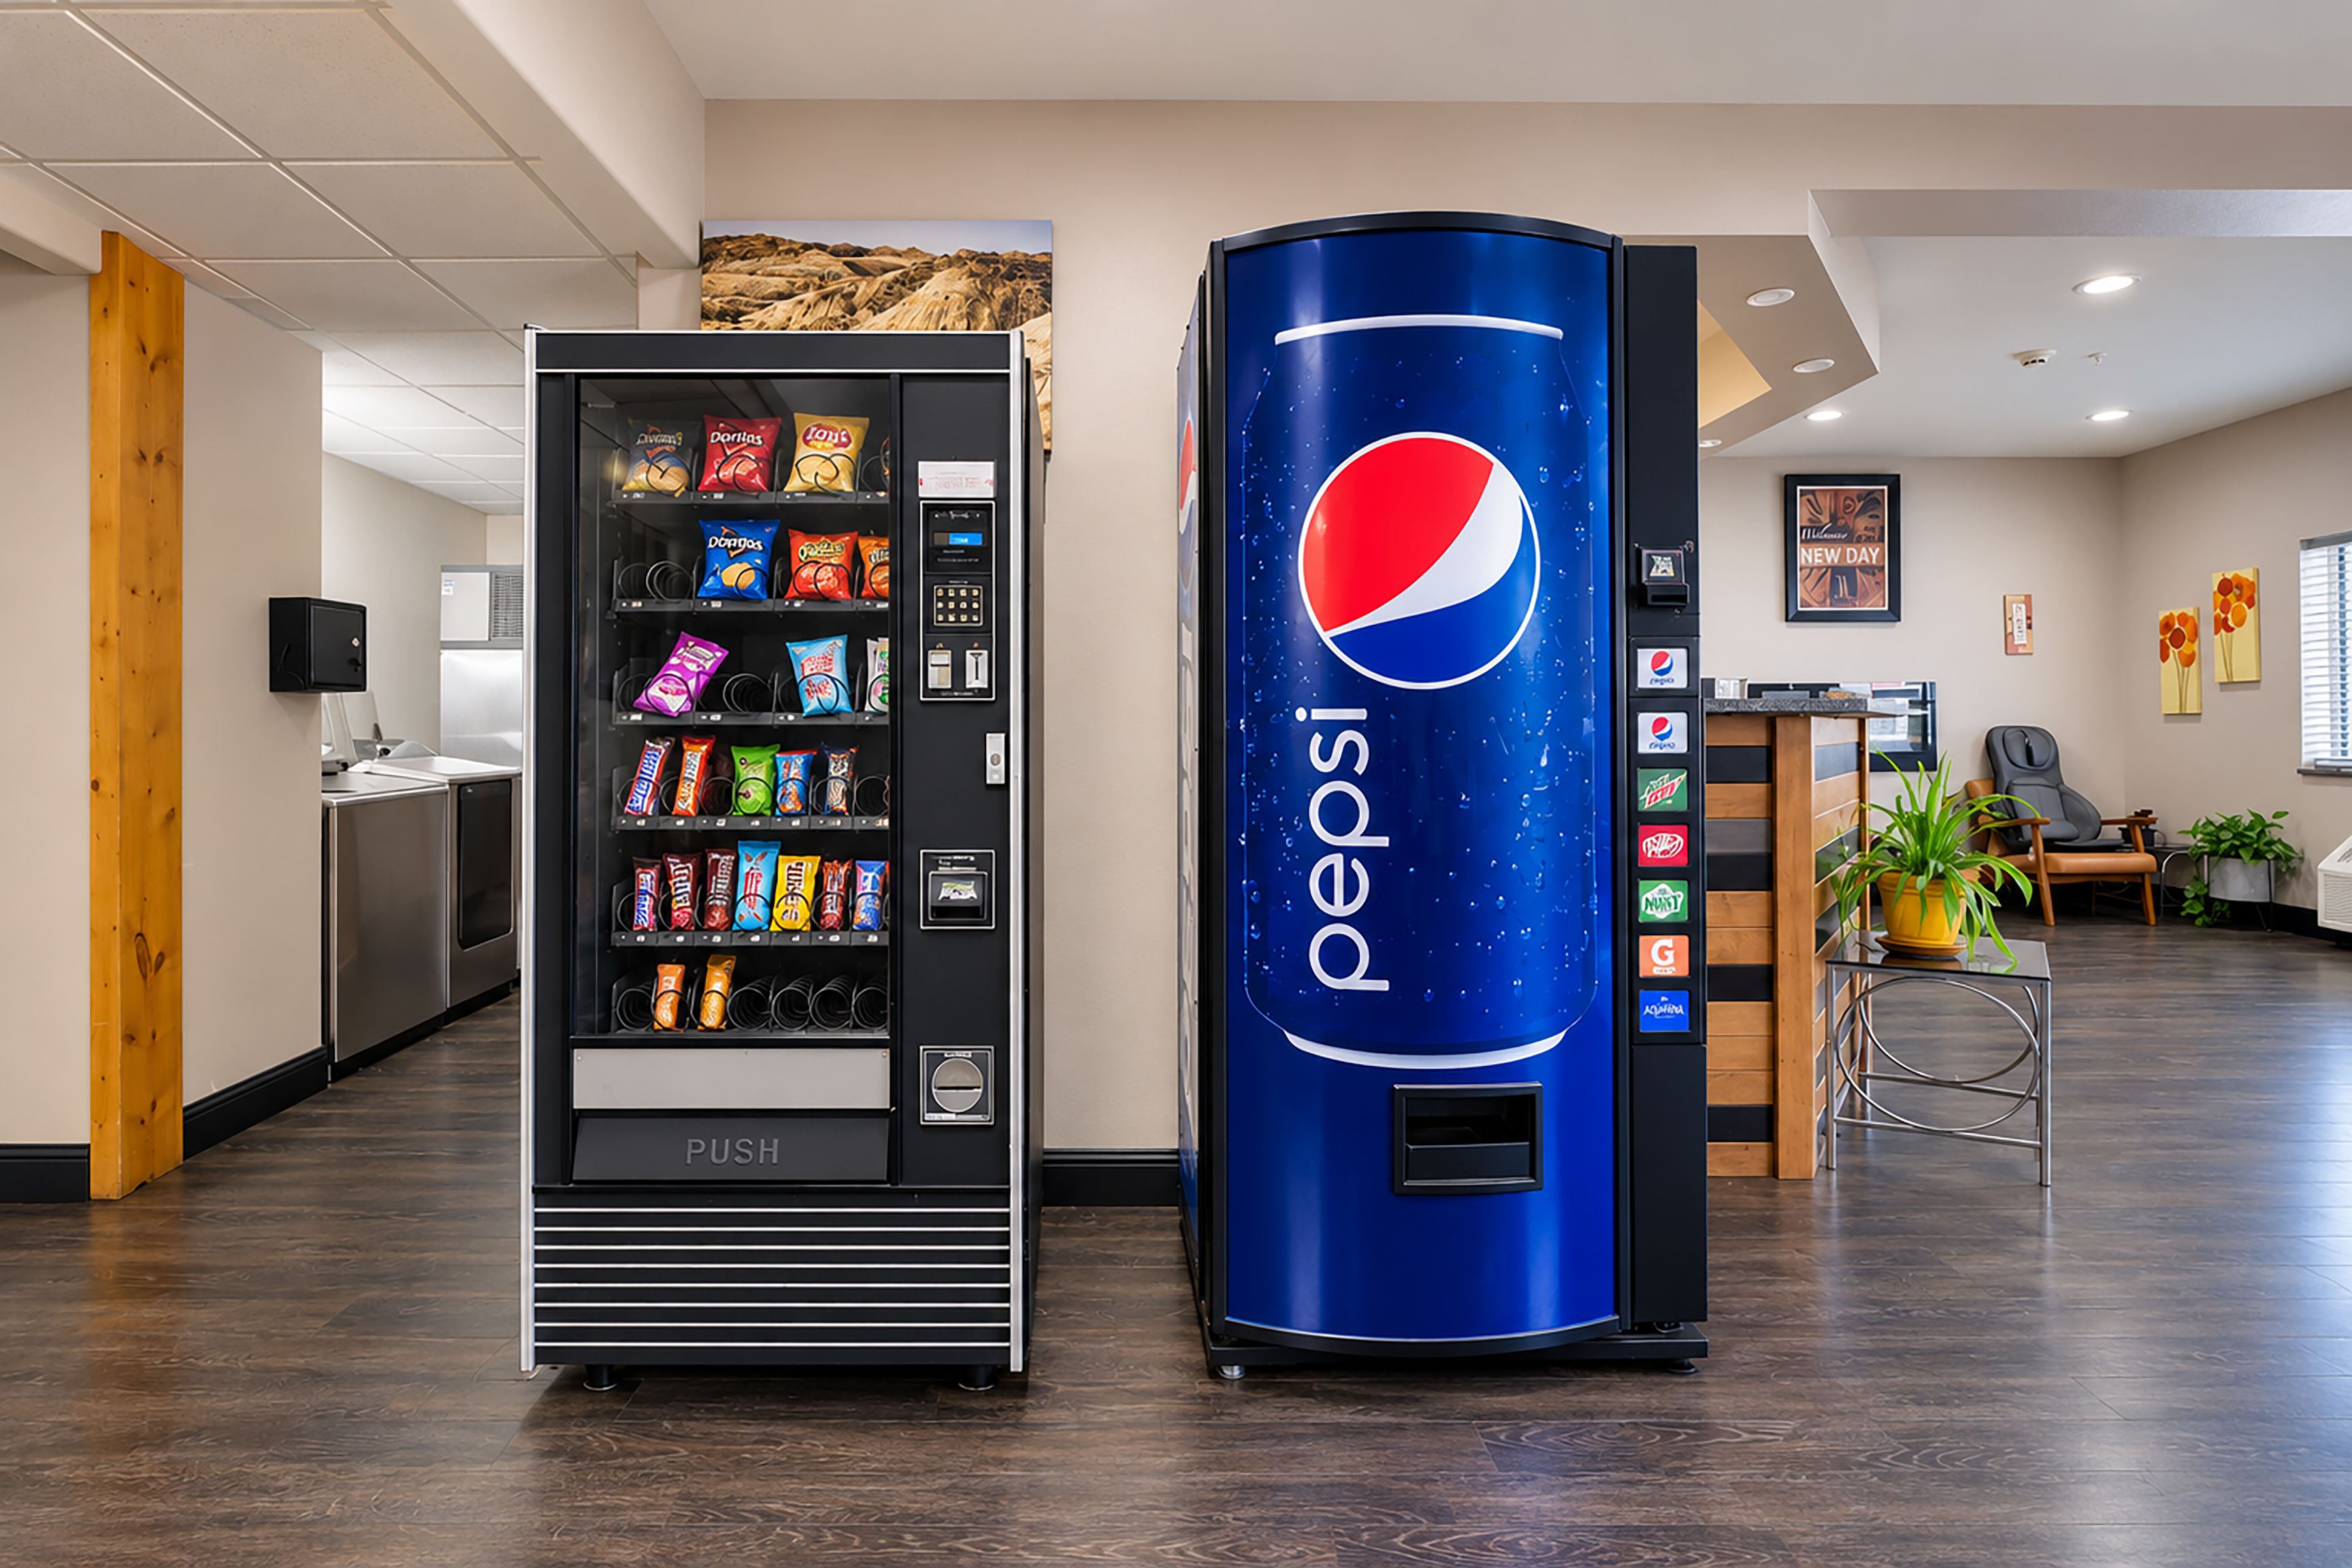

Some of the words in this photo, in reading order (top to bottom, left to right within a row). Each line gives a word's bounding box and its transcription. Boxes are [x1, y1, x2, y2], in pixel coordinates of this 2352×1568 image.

[1801, 547, 1842, 564] NEW
[1846, 547, 1880, 564] DAY
[1296, 705, 1390, 993] pepsi
[1651, 938, 1675, 966] G
[685, 1138, 779, 1165] PUSH
